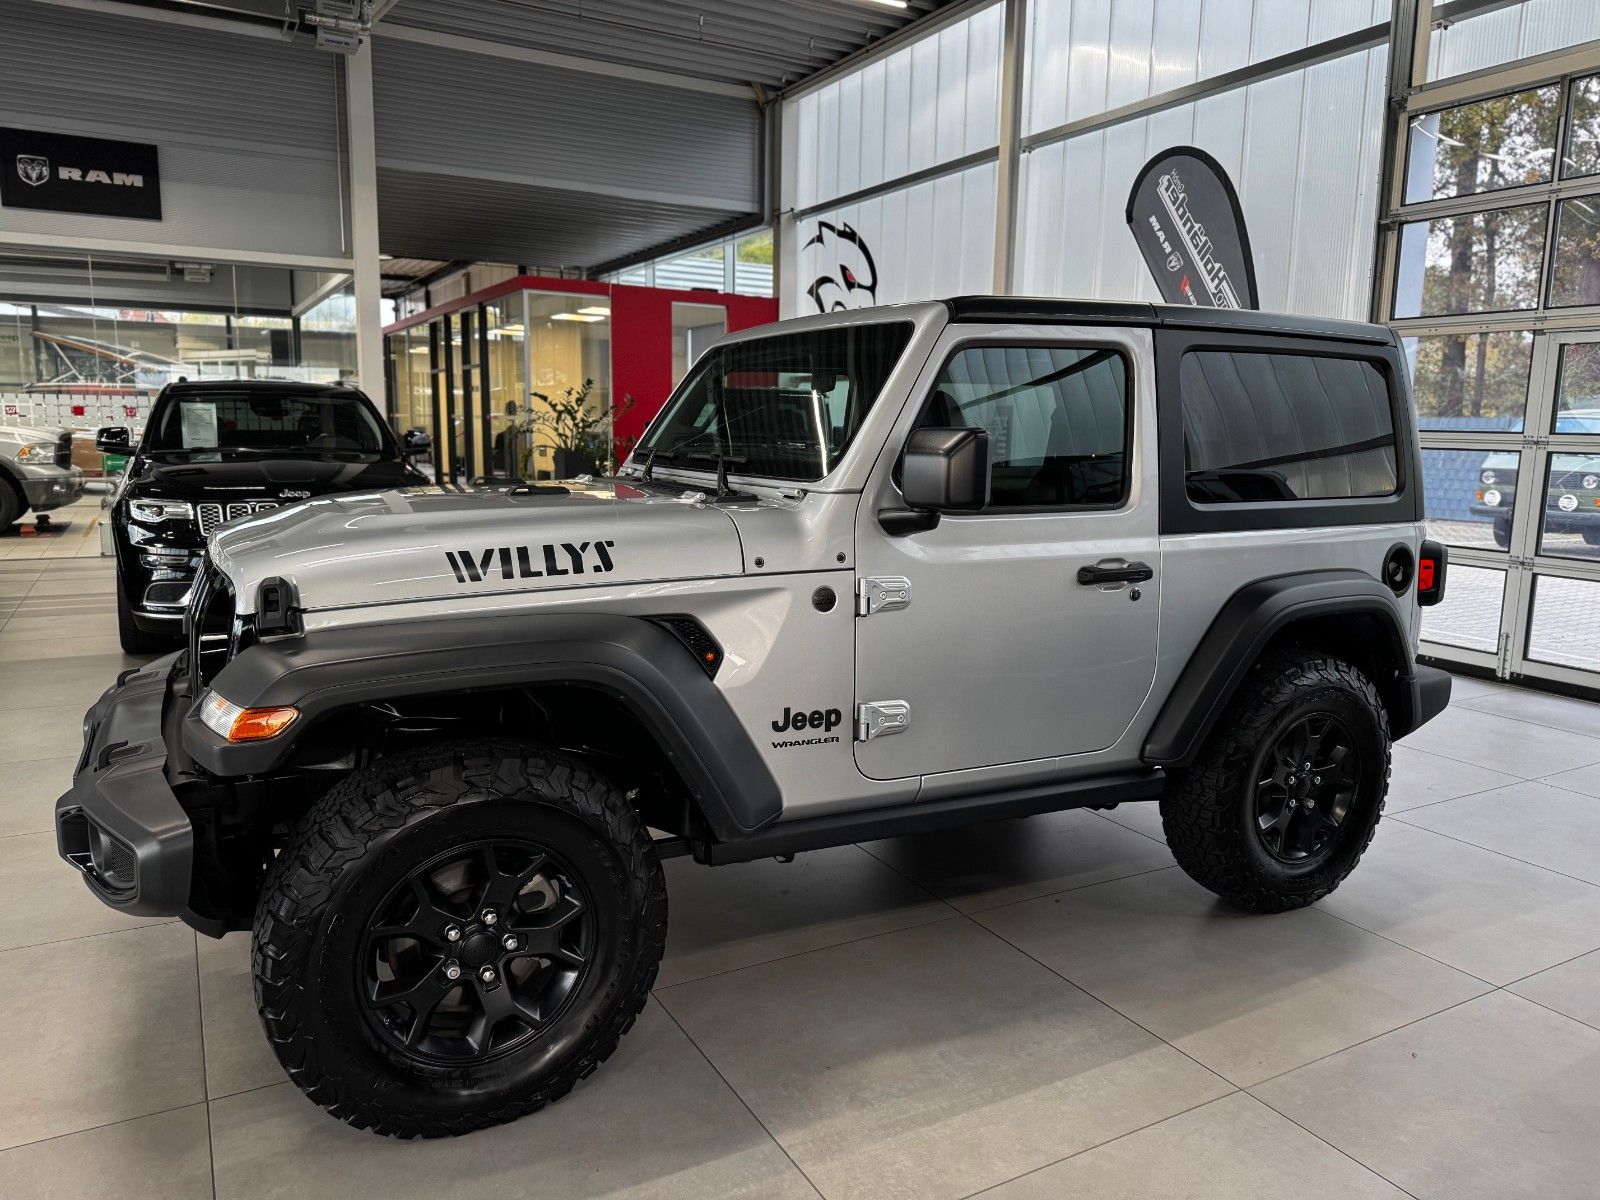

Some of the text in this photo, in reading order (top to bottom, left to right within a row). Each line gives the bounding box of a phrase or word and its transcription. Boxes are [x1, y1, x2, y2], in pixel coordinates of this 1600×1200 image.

[58, 166, 144, 188] RAM
[279, 488, 311, 499] Jeep
[445, 541, 615, 583] WILLYS
[771, 707, 842, 732] Jeep
[771, 736, 840, 749] WRANGLER
